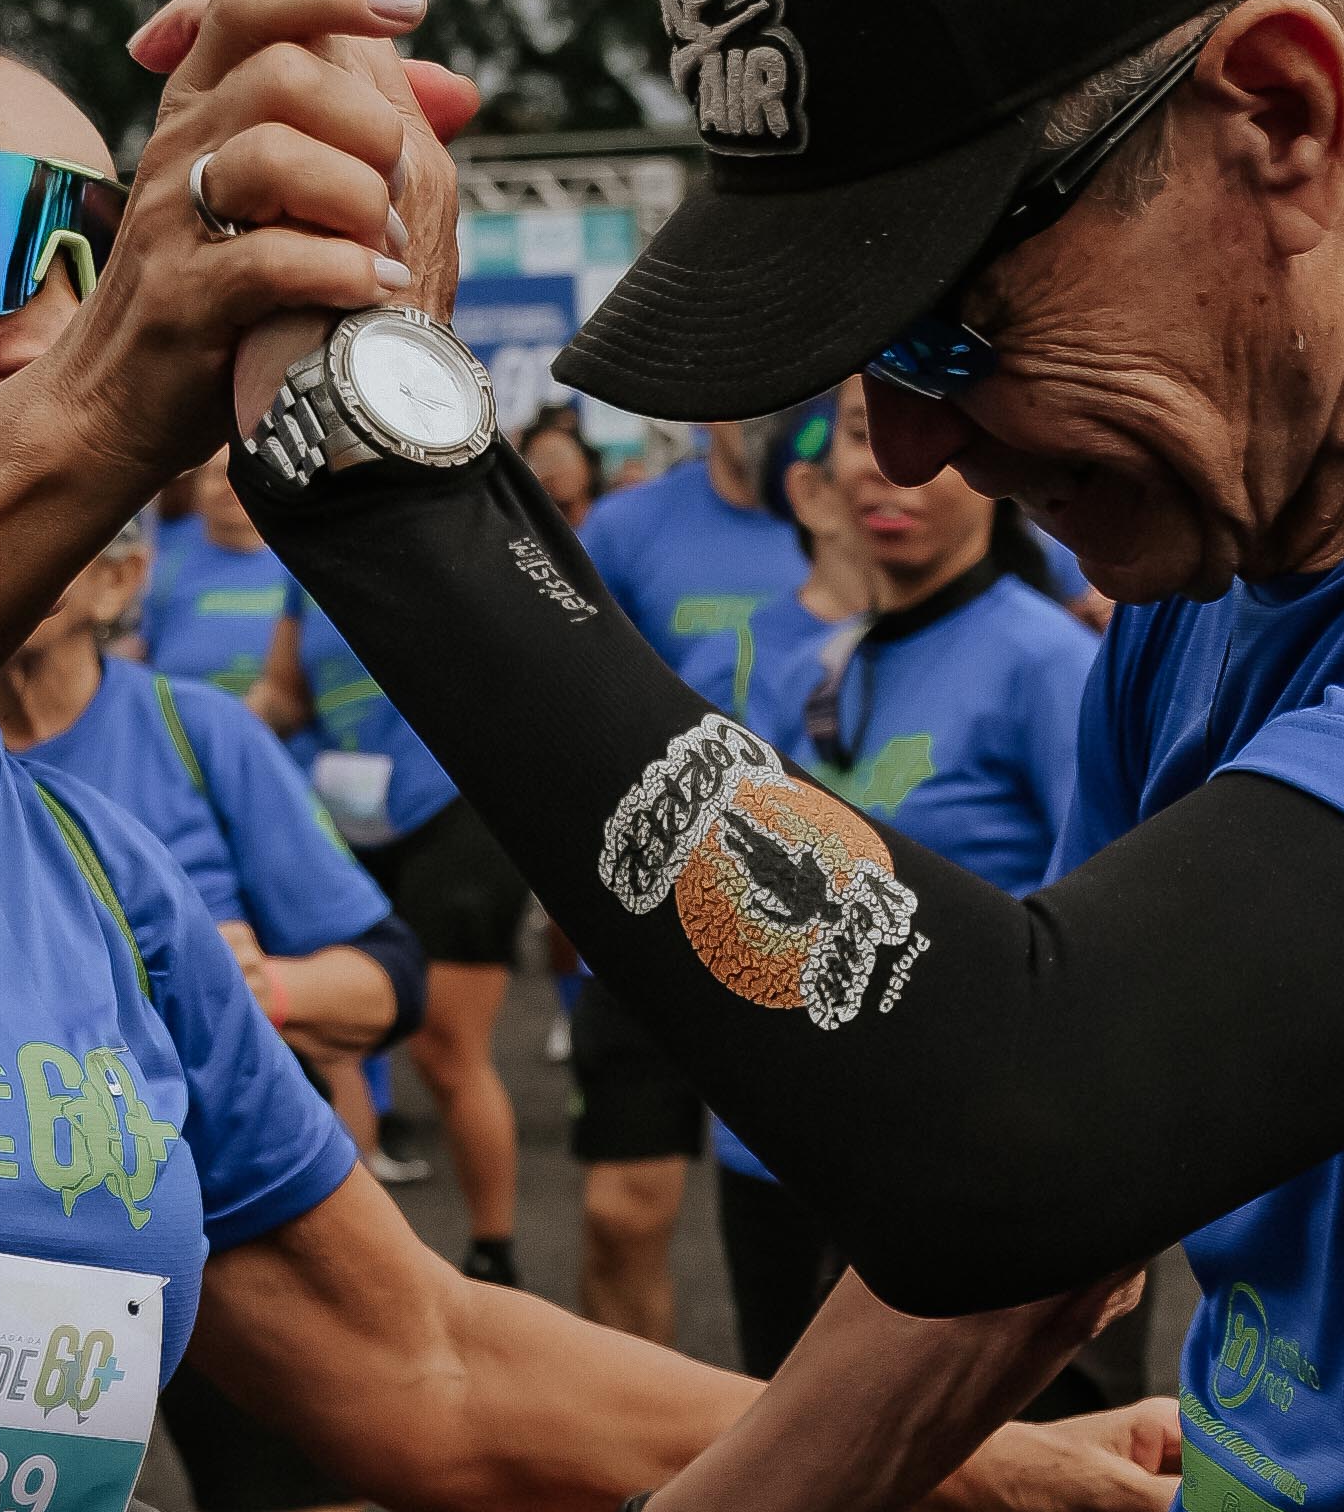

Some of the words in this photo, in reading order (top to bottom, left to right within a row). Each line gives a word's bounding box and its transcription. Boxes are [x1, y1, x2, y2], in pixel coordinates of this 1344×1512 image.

[878, 931, 931, 1014] Projeto
[16, 1041, 181, 1204] 60+
[32, 1324, 127, 1413] 60+
